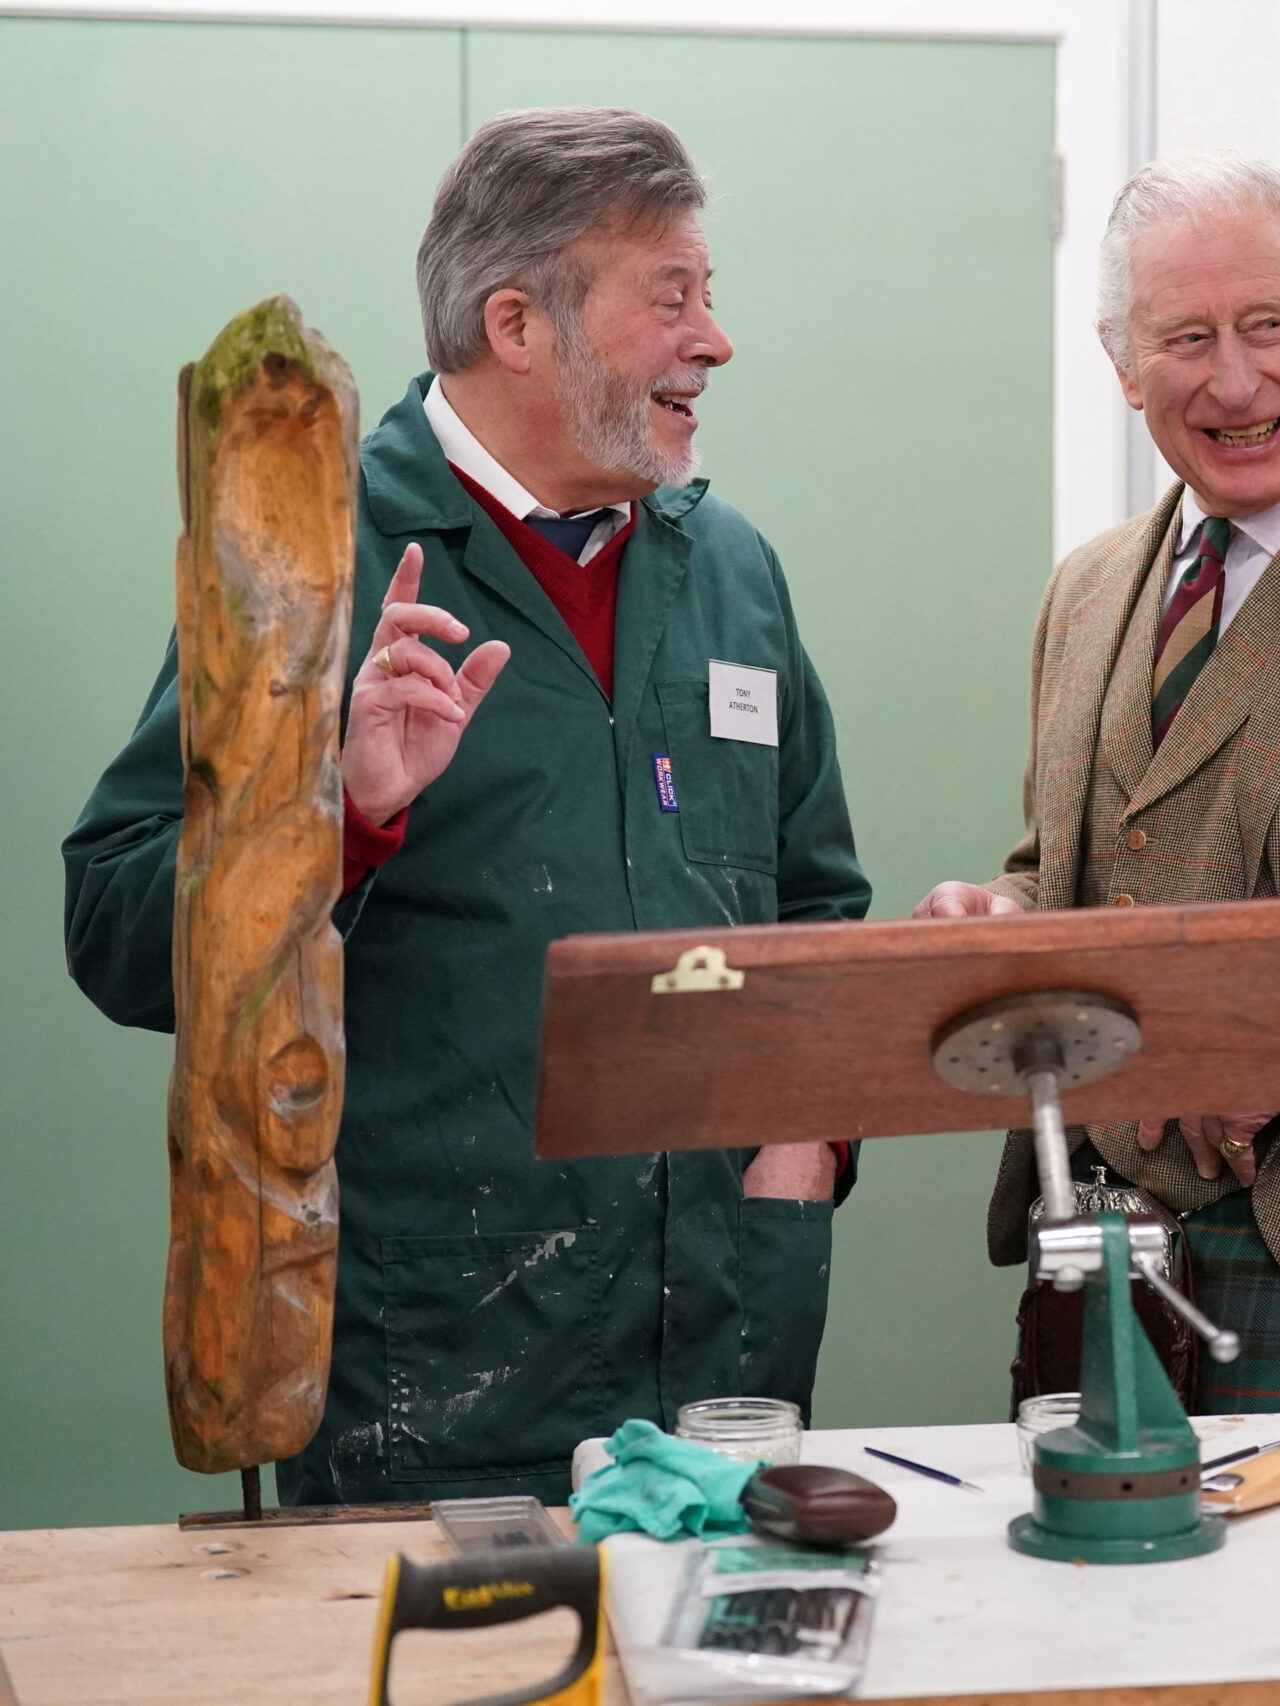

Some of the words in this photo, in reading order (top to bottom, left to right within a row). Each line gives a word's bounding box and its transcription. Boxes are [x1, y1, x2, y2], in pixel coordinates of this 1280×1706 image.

[736, 688, 751, 698] TONY
[729, 701, 758, 714] ATHERTON
[656, 758, 667, 805] WORKWEAR
[665, 774, 675, 801] CLICK
